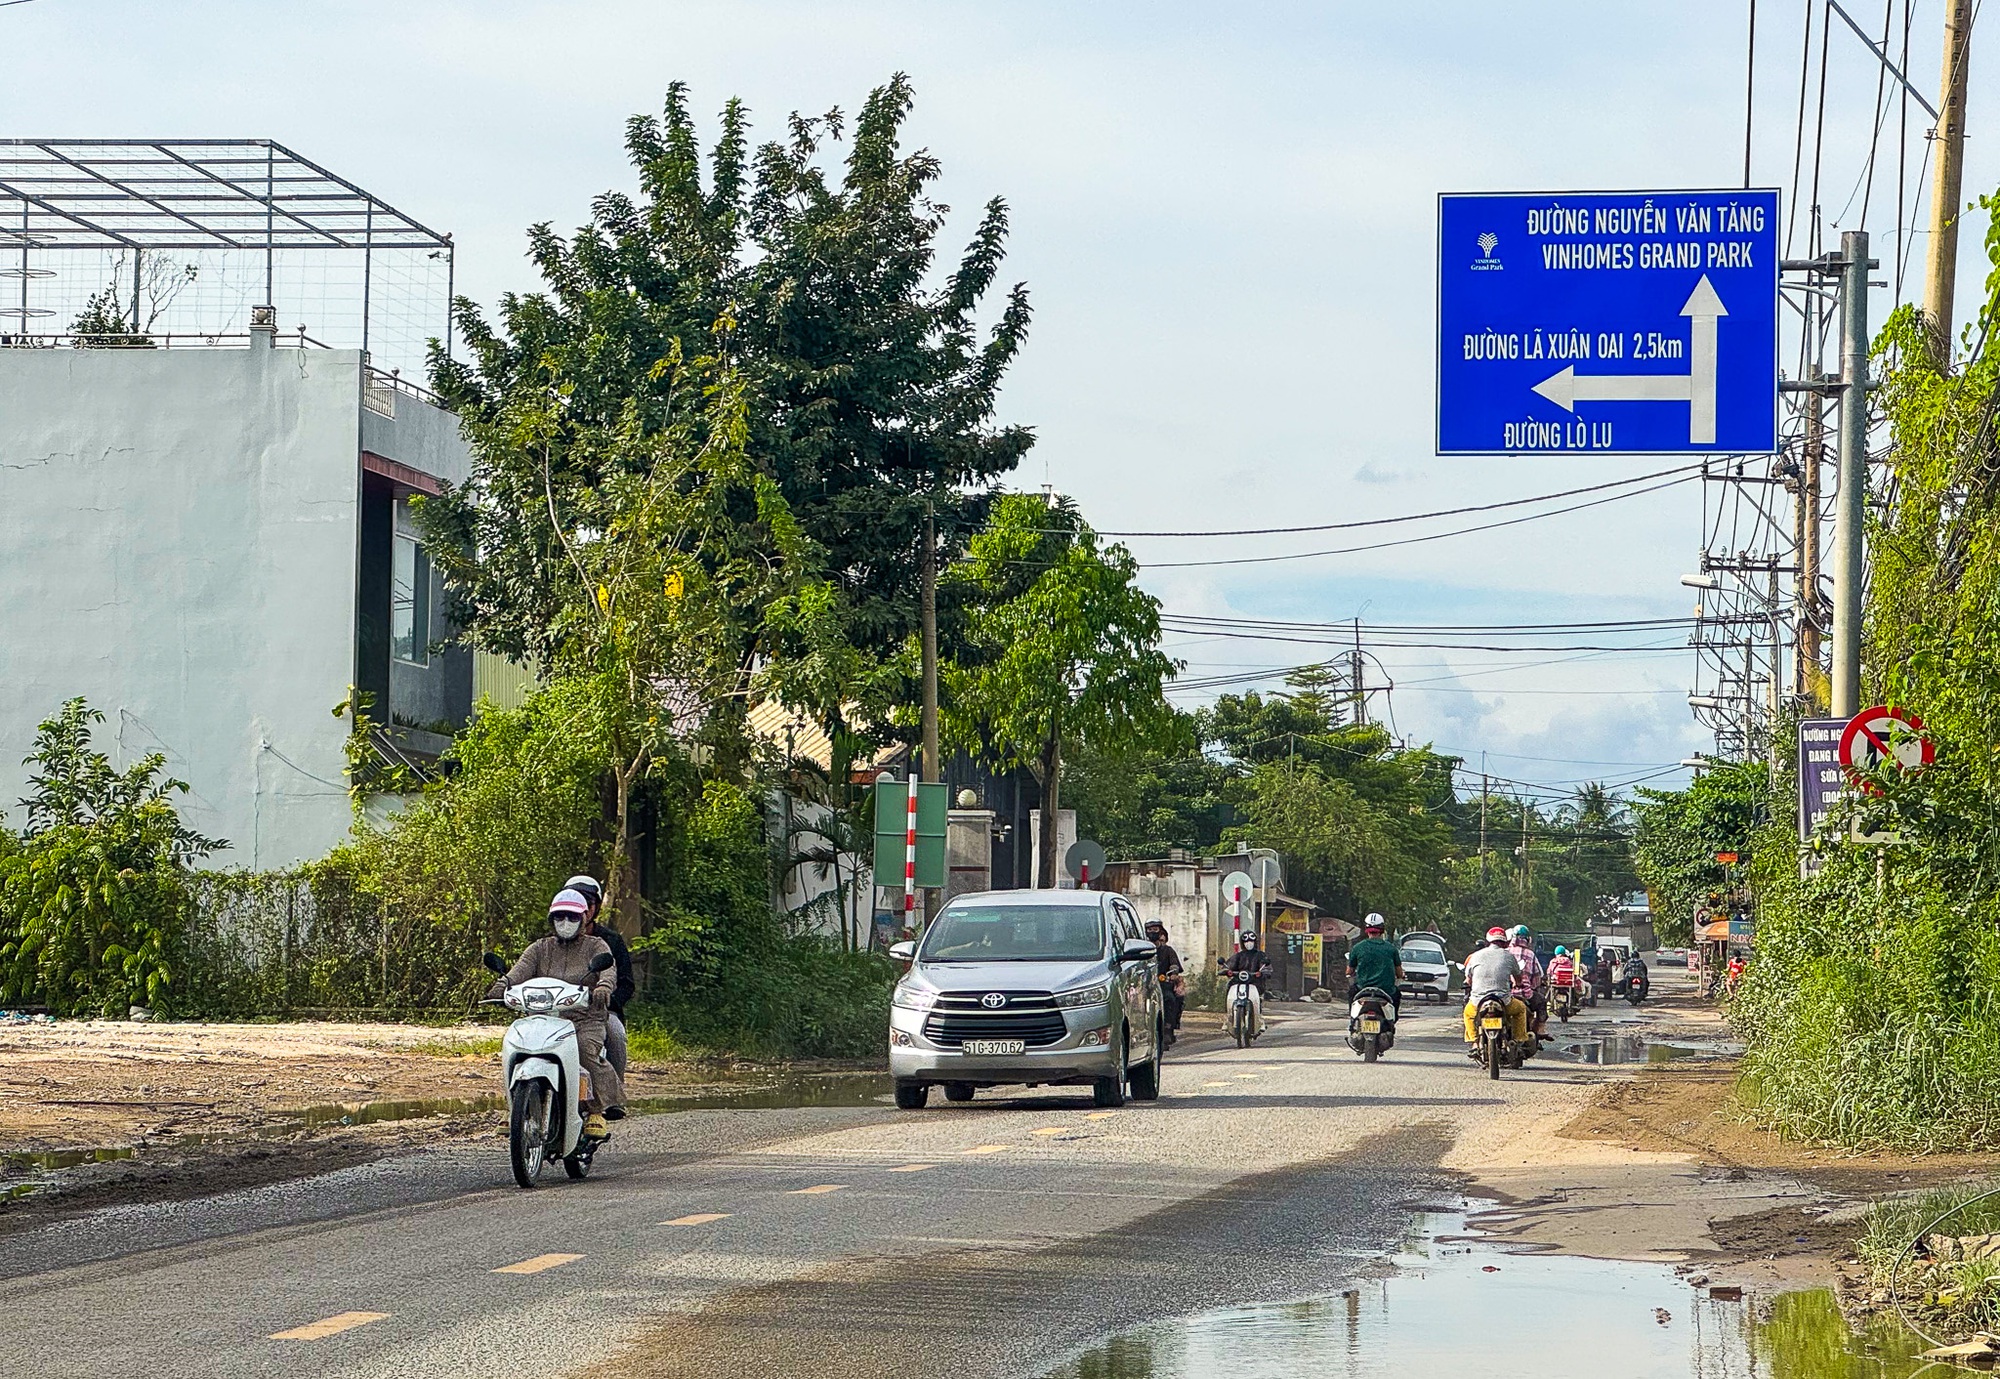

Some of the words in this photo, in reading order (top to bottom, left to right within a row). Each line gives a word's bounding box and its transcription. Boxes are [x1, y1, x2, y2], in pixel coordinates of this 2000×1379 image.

[1526, 202, 1589, 235] ĐƯỜNG
[1595, 199, 1667, 234] NGUYỄN
[1675, 202, 1711, 233] VĂN
[1716, 201, 1764, 233] TĂNG
[1542, 243, 1634, 270] VINHOMES
[1639, 242, 1701, 269] GRAND
[1707, 242, 1753, 268] PARK
[1463, 327, 1519, 360] ĐƯỜNG
[1524, 328, 1544, 360] LÃ
[1547, 327, 1590, 360] XUÂN
[1598, 332, 1623, 359] OAI
[1633, 332, 1683, 360] 2,5km
[1503, 415, 1561, 448] ĐƯỜNG
[1566, 415, 1587, 448] LÒ
[1592, 422, 1612, 448] LU
[964, 1042, 1022, 1054] 51G-370.62
